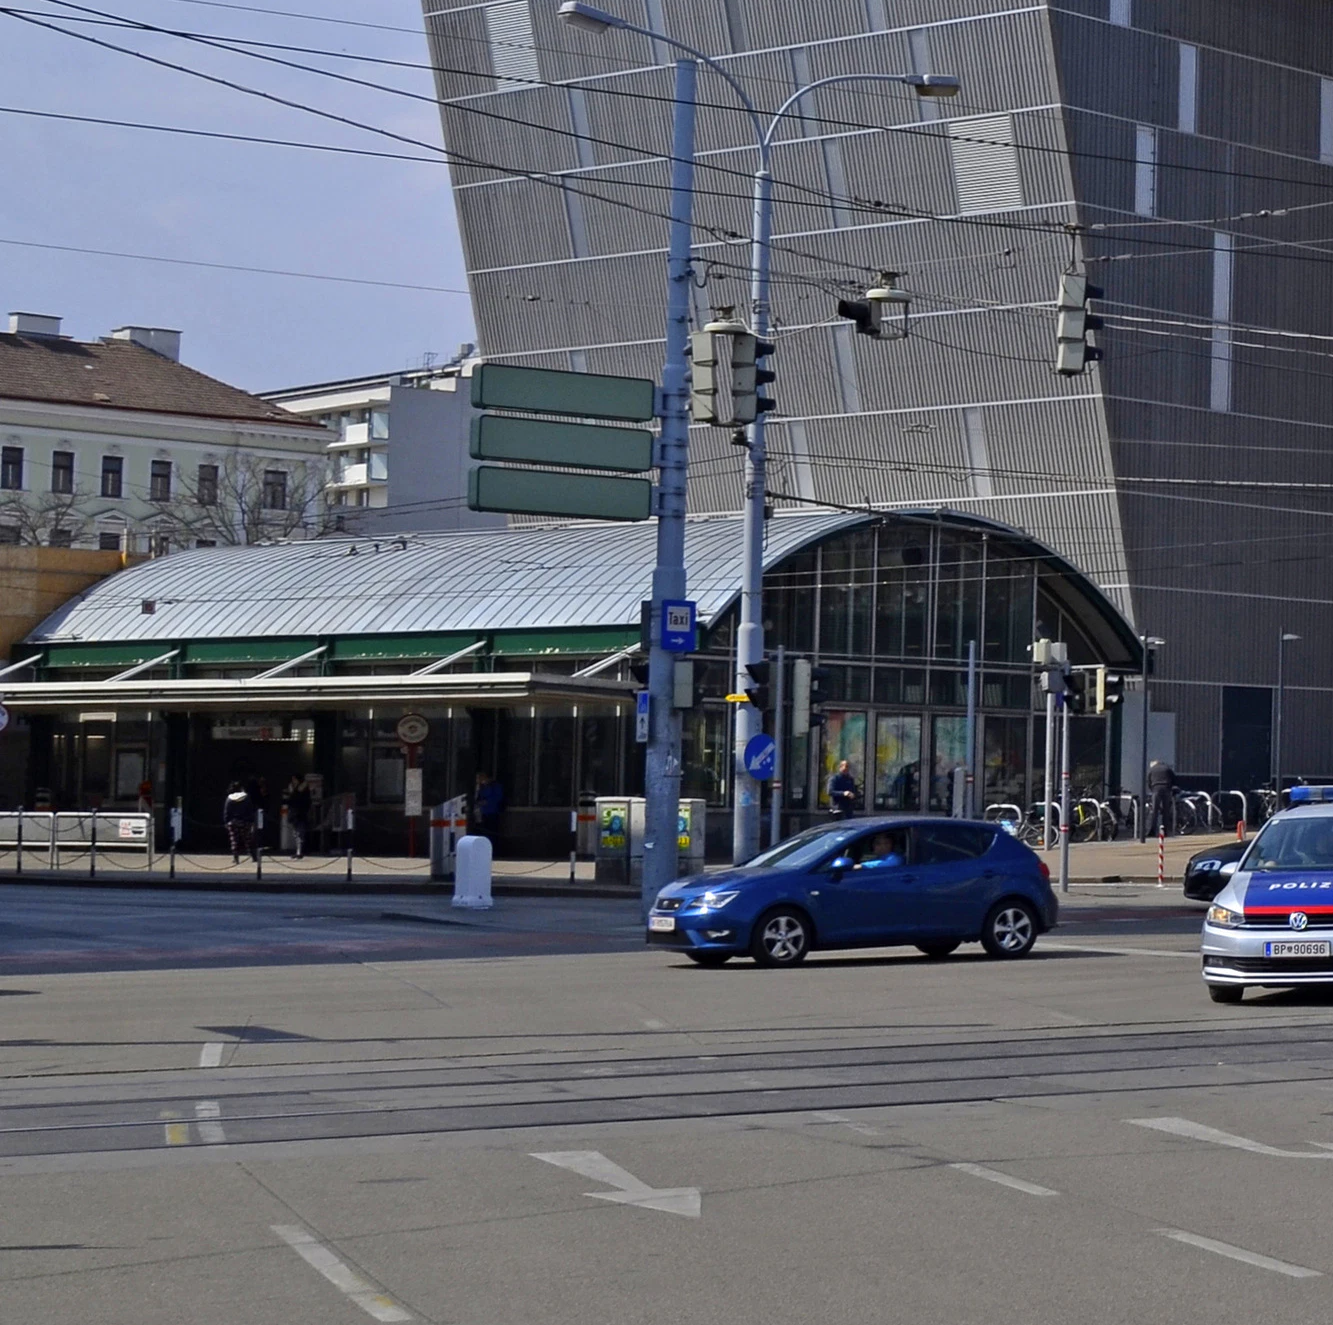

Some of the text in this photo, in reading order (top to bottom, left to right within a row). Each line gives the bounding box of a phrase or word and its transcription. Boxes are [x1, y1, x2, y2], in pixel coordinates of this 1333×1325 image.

[668, 611, 690, 626] Taxi
[1273, 943, 1326, 955] BP 90696
